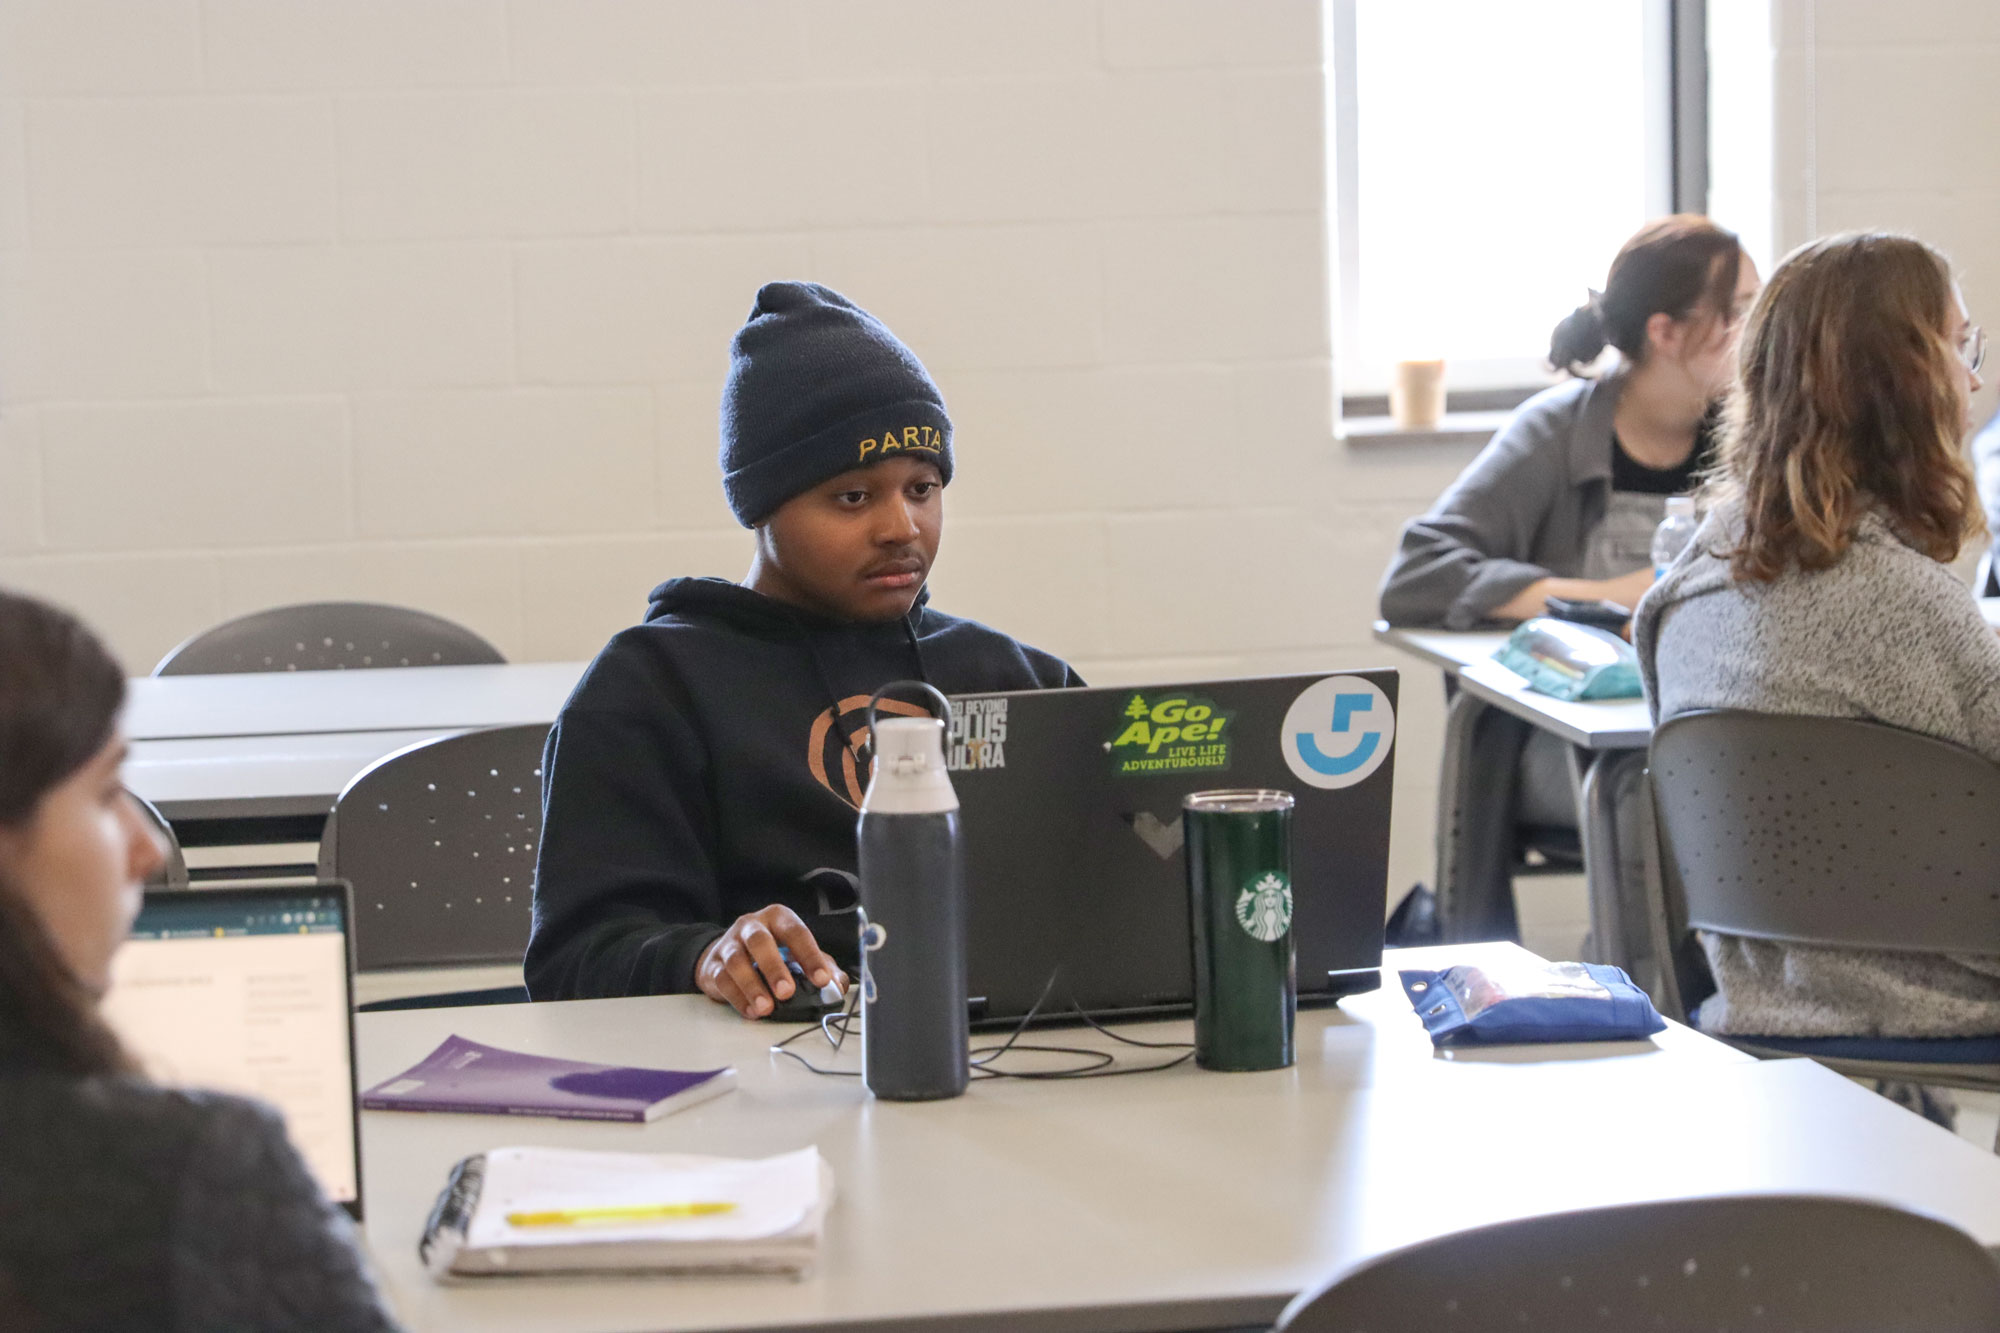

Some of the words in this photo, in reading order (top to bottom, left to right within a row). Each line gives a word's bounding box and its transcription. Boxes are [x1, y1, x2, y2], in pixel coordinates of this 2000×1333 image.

[966, 698, 1008, 714] BEYOND
[1150, 699, 1211, 723] Go
[951, 713, 1007, 744] PLUS
[1113, 718, 1226, 753] Ape!
[1169, 747, 1197, 757] LIVE
[1200, 744, 1226, 755] LIFE
[1122, 755, 1225, 771] ADVENTUROUSLY
